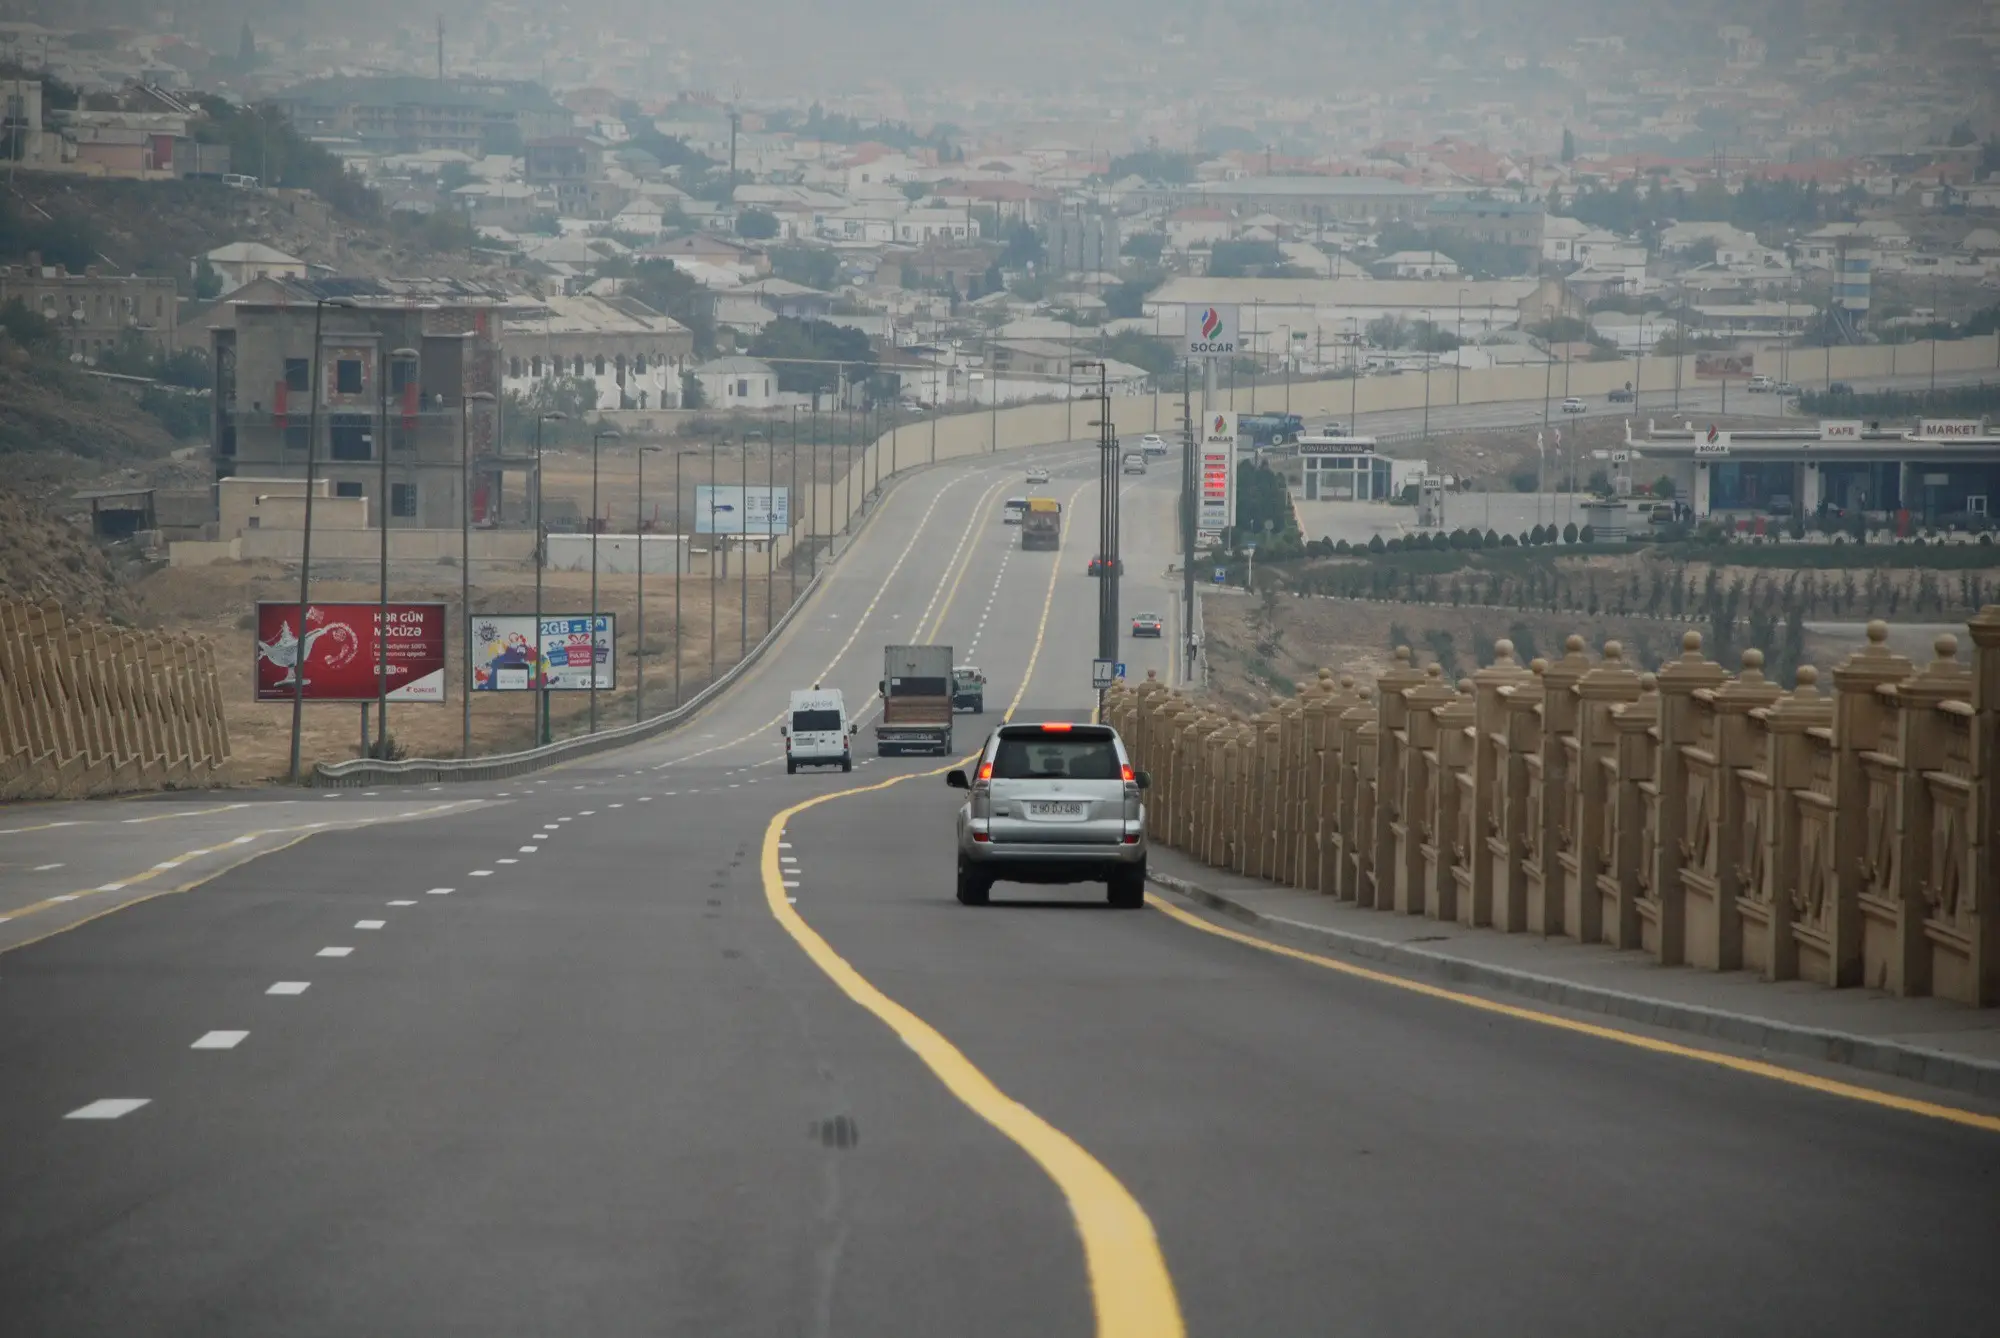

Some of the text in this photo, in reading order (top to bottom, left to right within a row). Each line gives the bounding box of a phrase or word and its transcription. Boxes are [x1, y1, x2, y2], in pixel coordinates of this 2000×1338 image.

[1190, 343, 1233, 352] SOCAR
[1828, 427, 1854, 435] KAFE
[1927, 425, 1977, 434] MARKET
[400, 611, 424, 622] GÜN
[541, 621, 570, 635] 2GB
